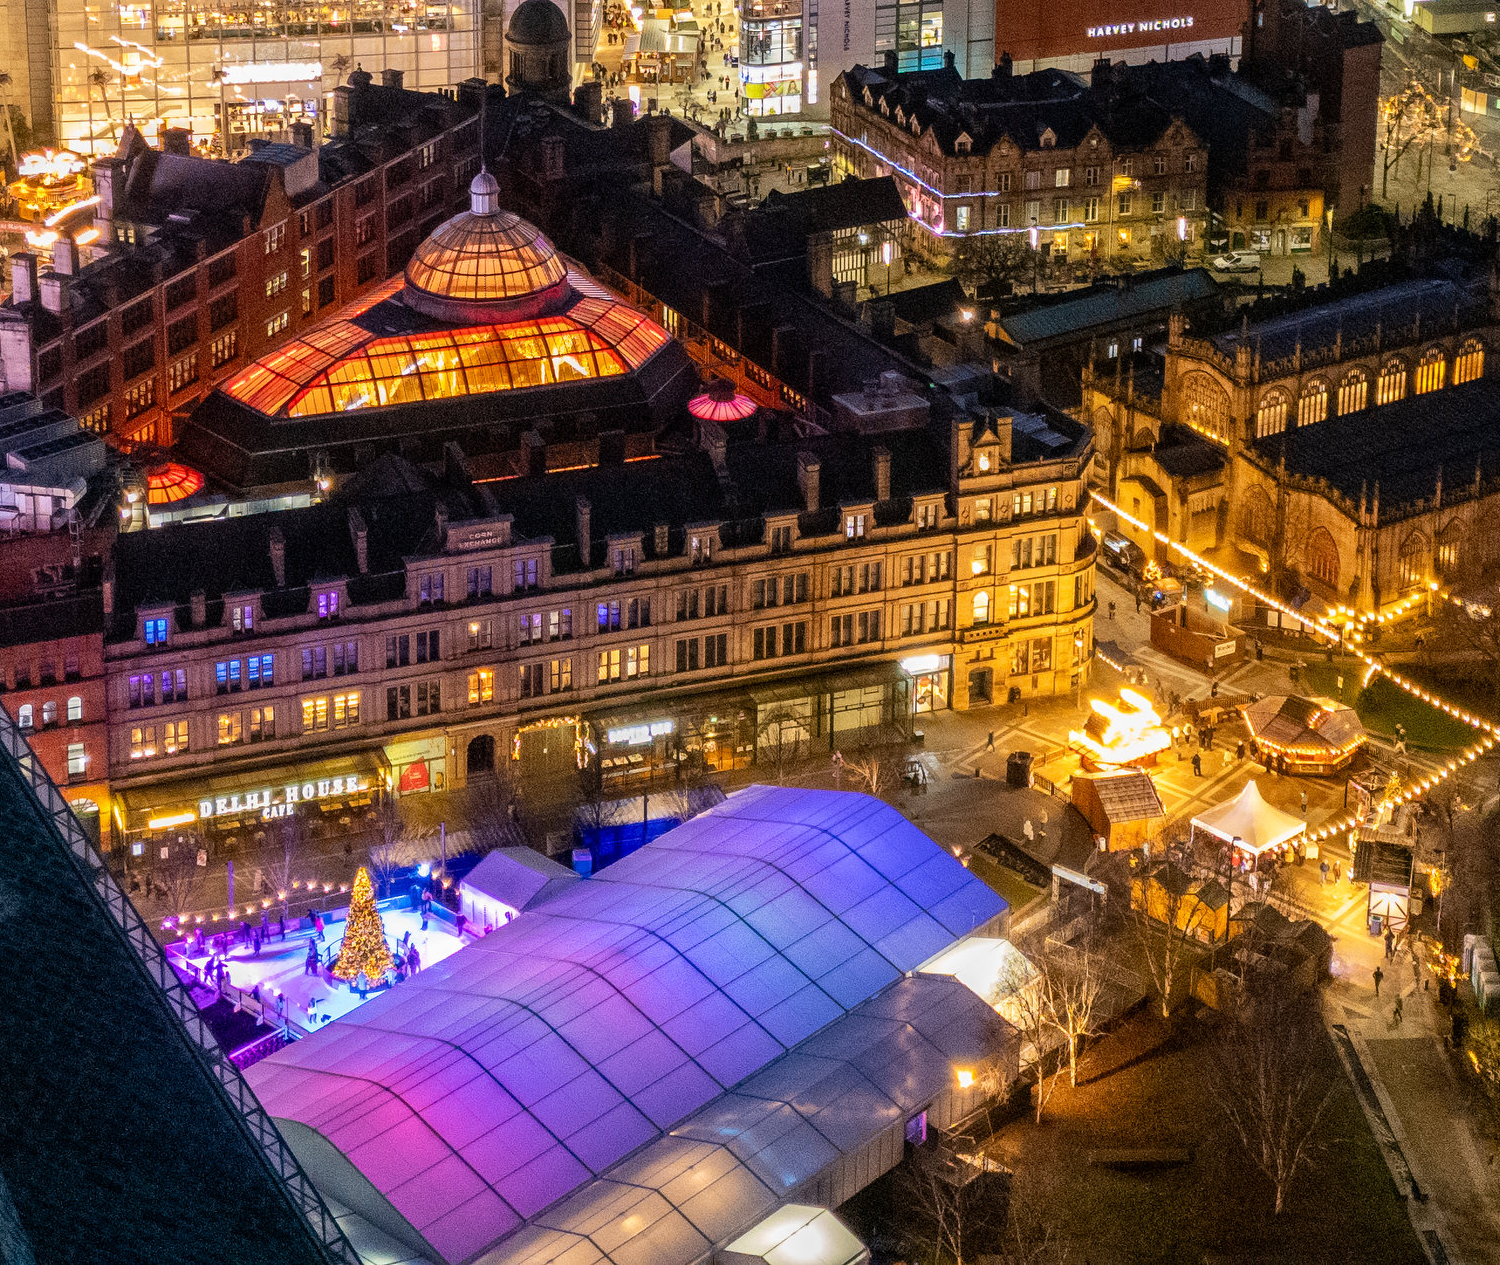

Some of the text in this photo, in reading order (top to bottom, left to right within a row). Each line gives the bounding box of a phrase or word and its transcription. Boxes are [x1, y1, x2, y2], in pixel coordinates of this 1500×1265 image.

[1087, 16, 1195, 38] HARVEY NICHOLS
[458, 537, 503, 548] EXCHANGE
[468, 531, 493, 540] CORN
[199, 776, 358, 818] DELHI HOUSE
[262, 802, 294, 820] CAFE
